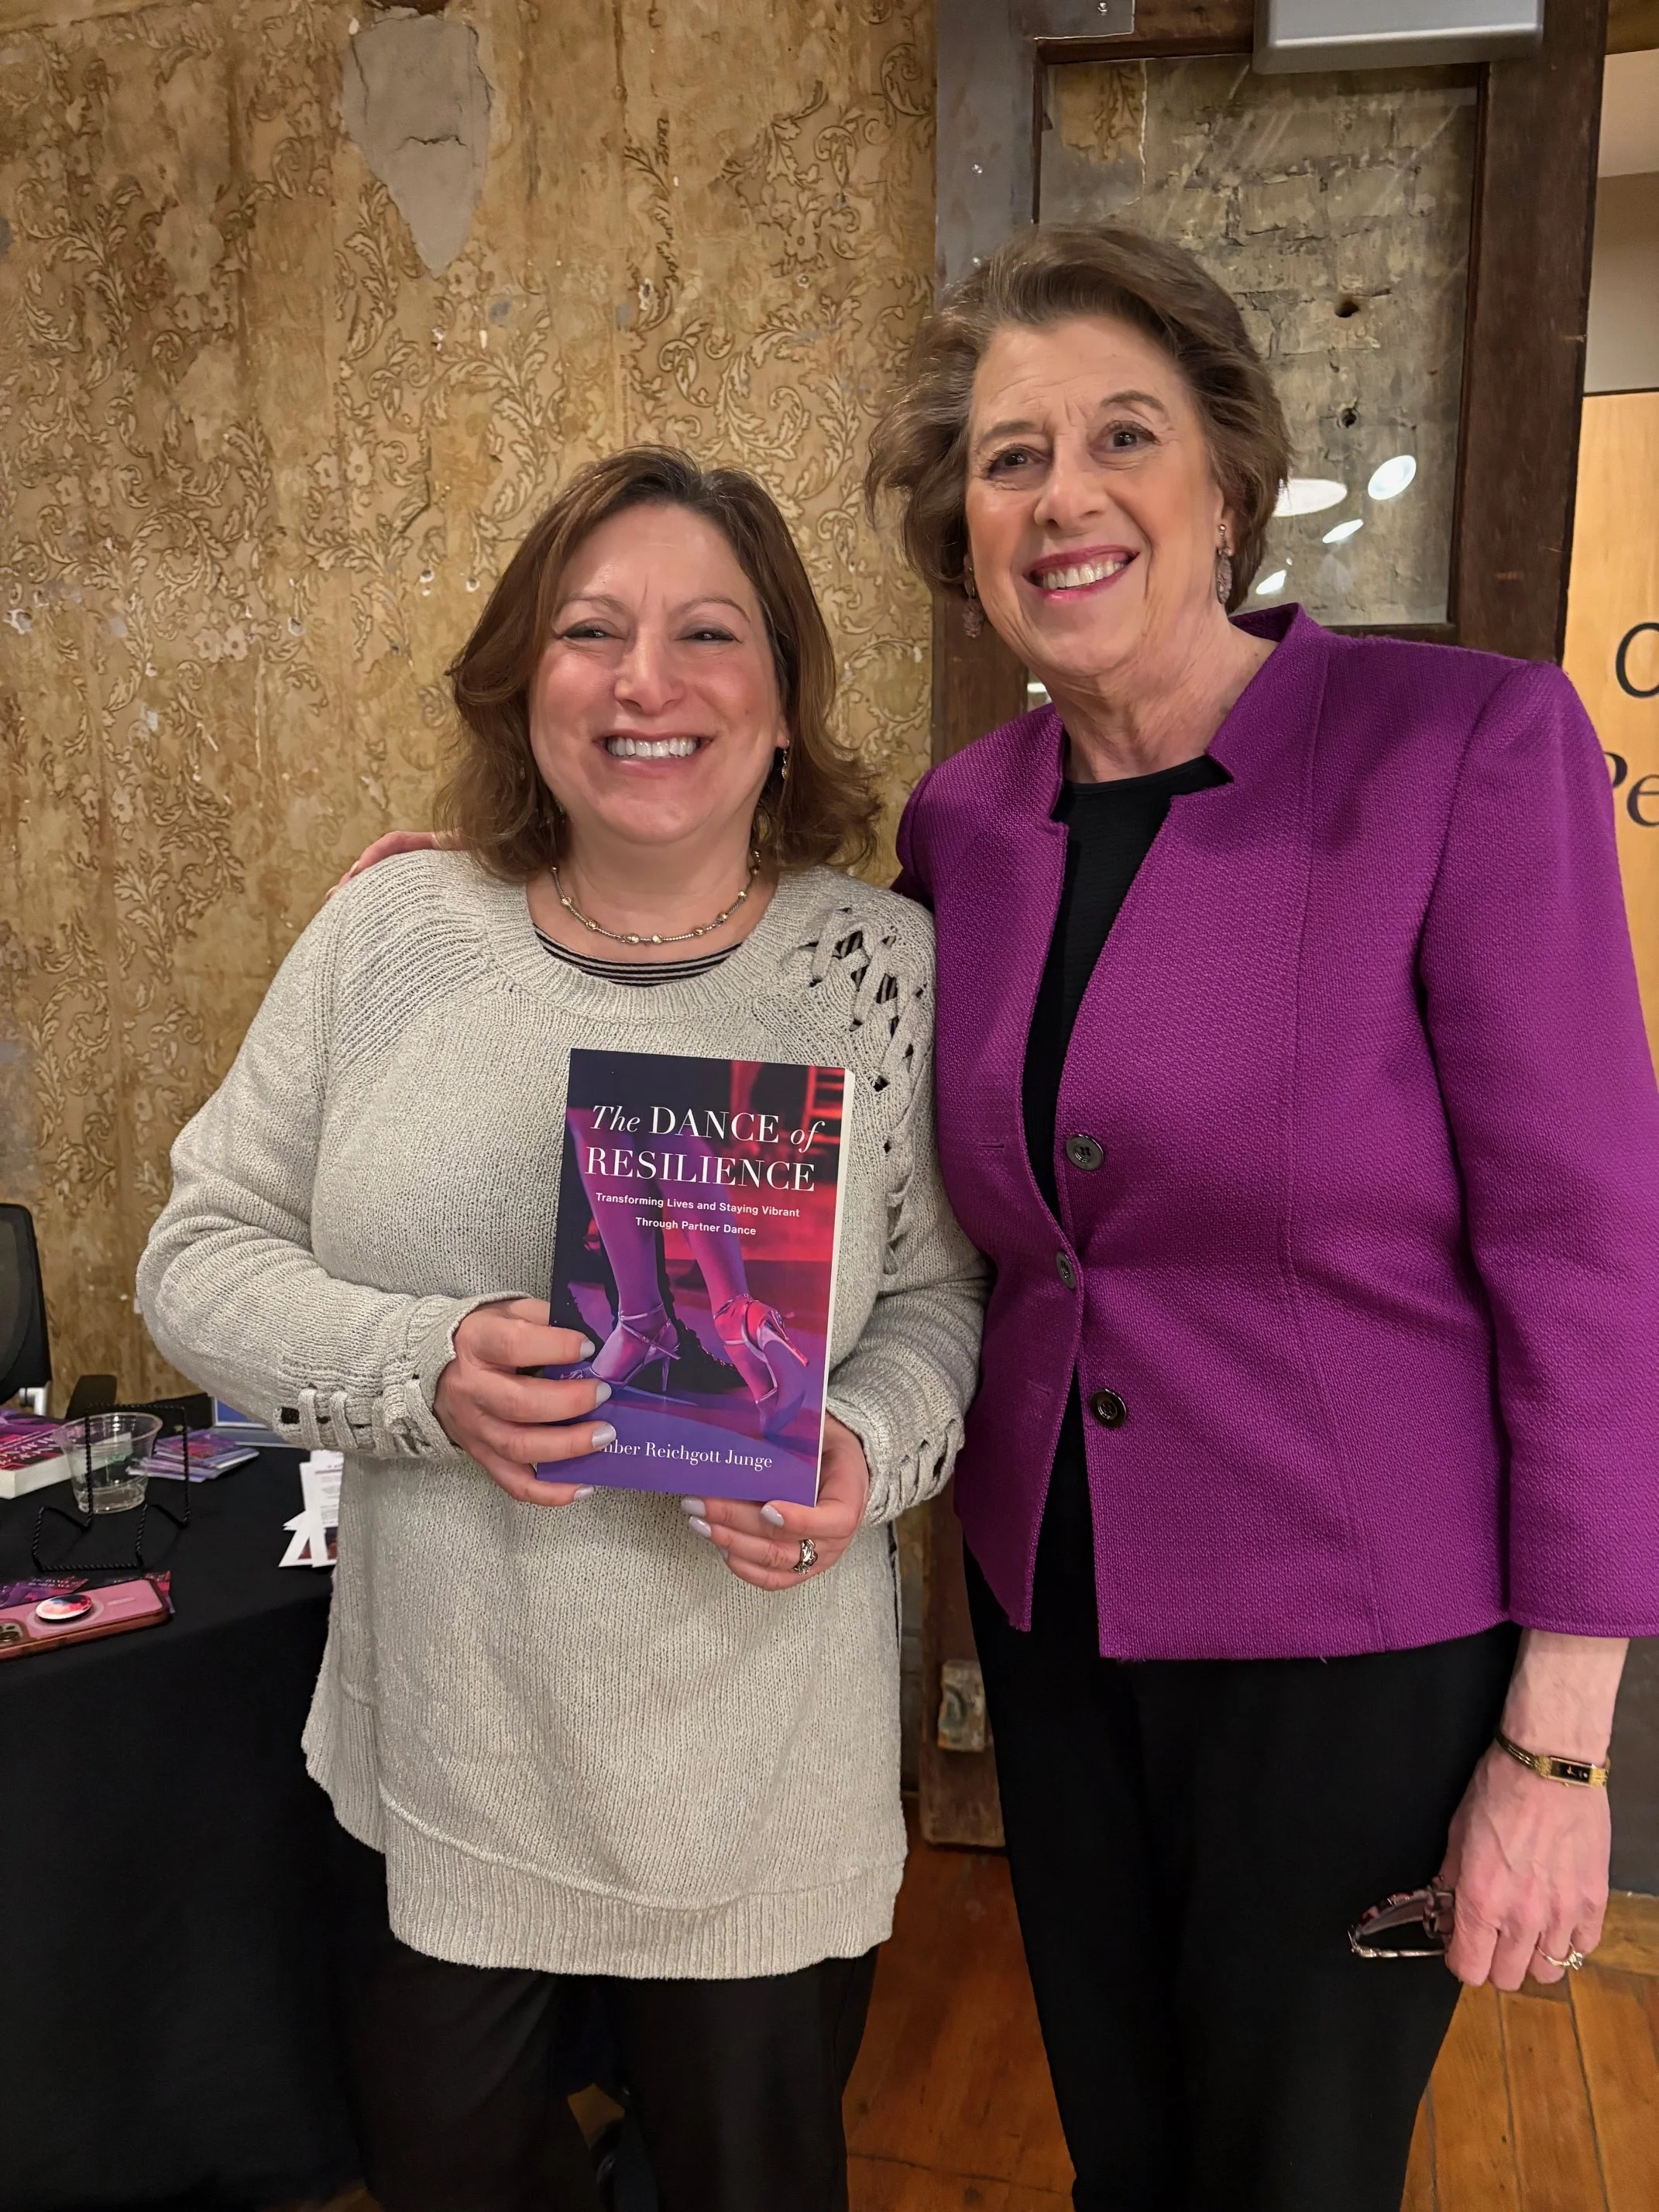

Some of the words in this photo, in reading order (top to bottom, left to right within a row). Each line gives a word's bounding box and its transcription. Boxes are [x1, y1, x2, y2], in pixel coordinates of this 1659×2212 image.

[590, 1105, 641, 1132] The
[648, 1106, 779, 1142] DANCE
[790, 1121, 825, 1153] of
[585, 1146, 815, 1191] RESILIENCE
[596, 1193, 664, 1207] Transforming
[667, 1199, 694, 1208] Lives
[697, 1202, 716, 1211] and
[720, 1202, 758, 1215] Staying
[762, 1206, 799, 1217] Vibrant
[635, 1217, 678, 1230] Through
[682, 1221, 720, 1232] Partner
[723, 1224, 757, 1235] Dance
[645, 1441, 721, 1465] Reichgott
[725, 1449, 773, 1472] Junge
